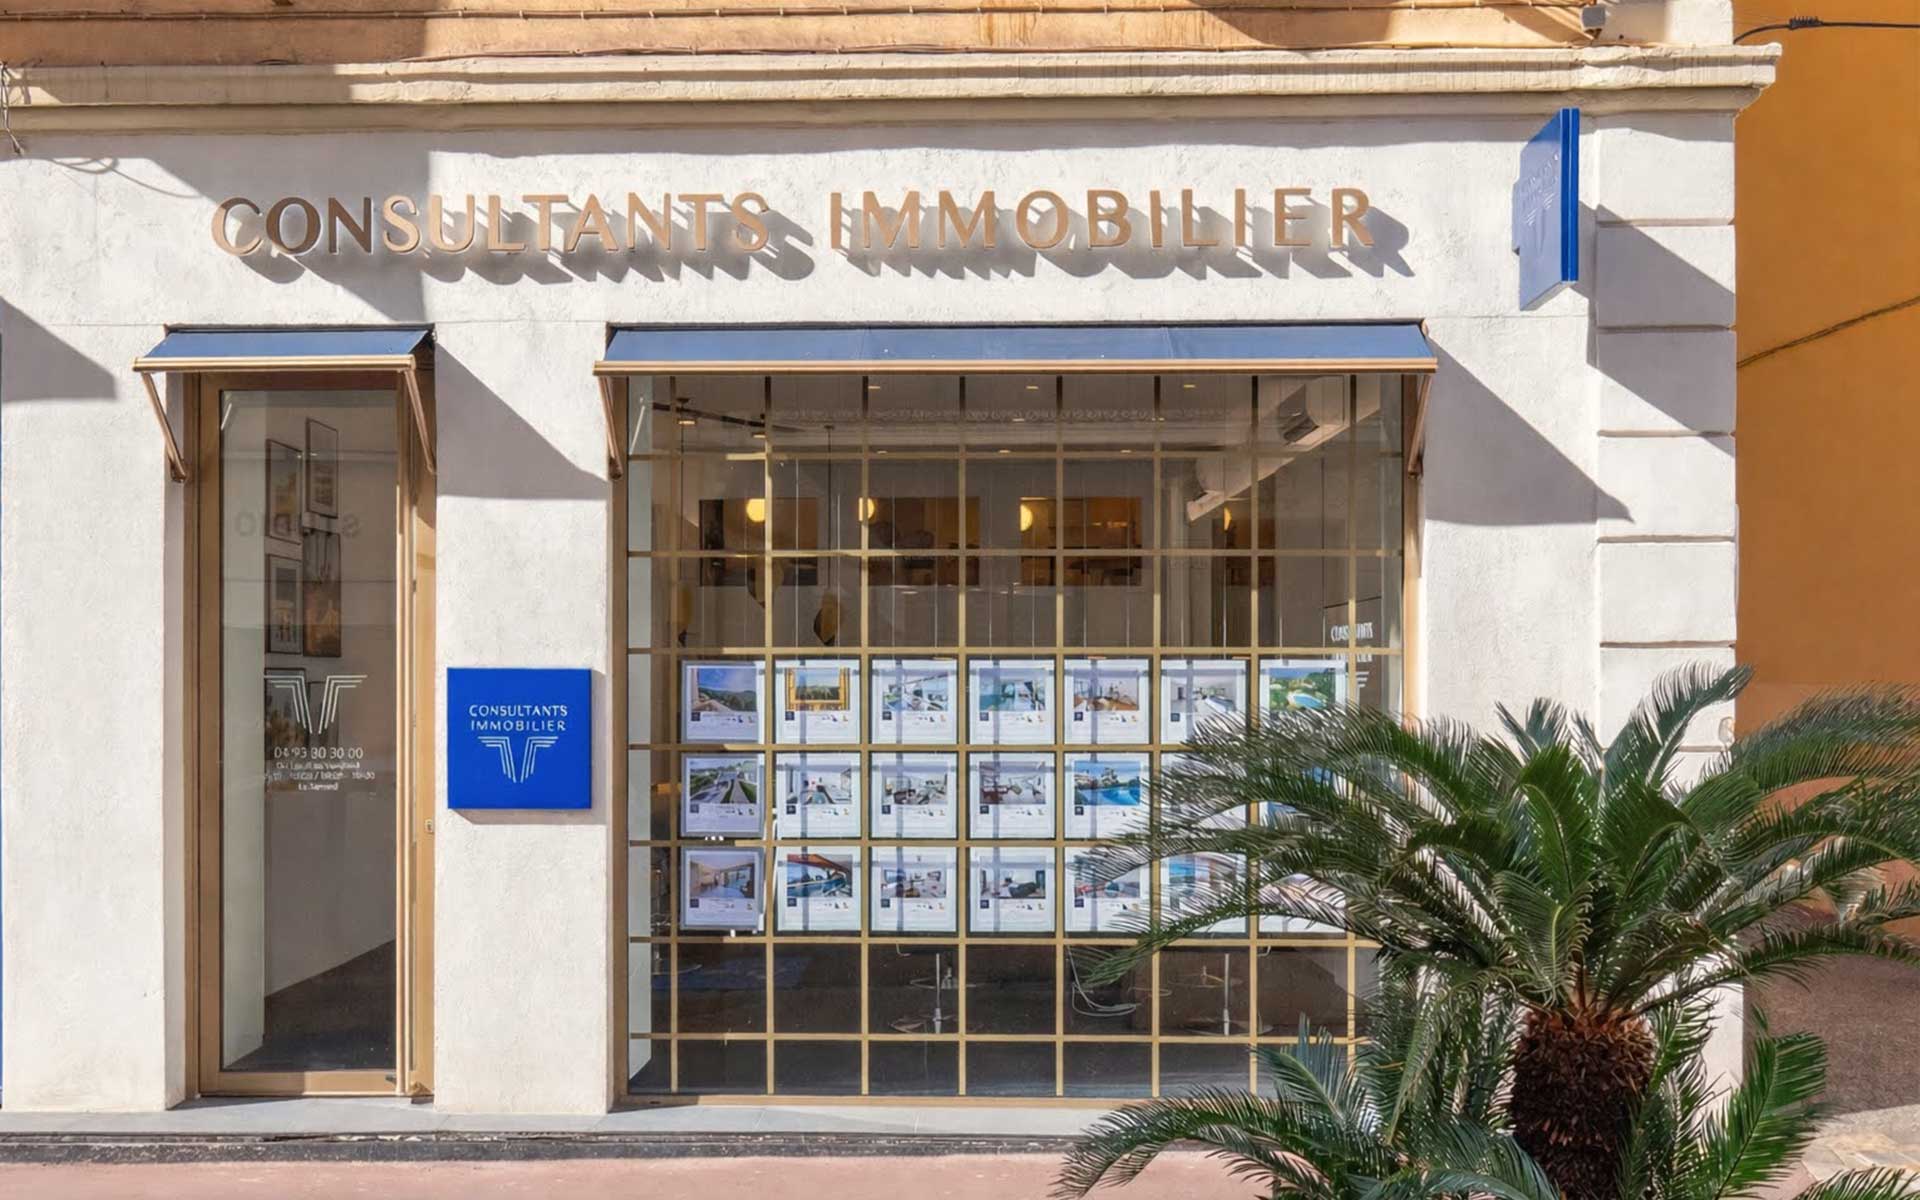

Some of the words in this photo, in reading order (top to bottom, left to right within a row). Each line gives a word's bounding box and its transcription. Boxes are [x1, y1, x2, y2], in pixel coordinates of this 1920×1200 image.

[212, 192, 770, 255] CONSULTANTS
[830, 187, 1375, 250] IMMOBILIER
[469, 704, 568, 717] CONSULTANTS
[471, 720, 566, 732] IMMOBILIER
[330, 746, 345, 760] 30
[348, 746, 364, 760] 00
